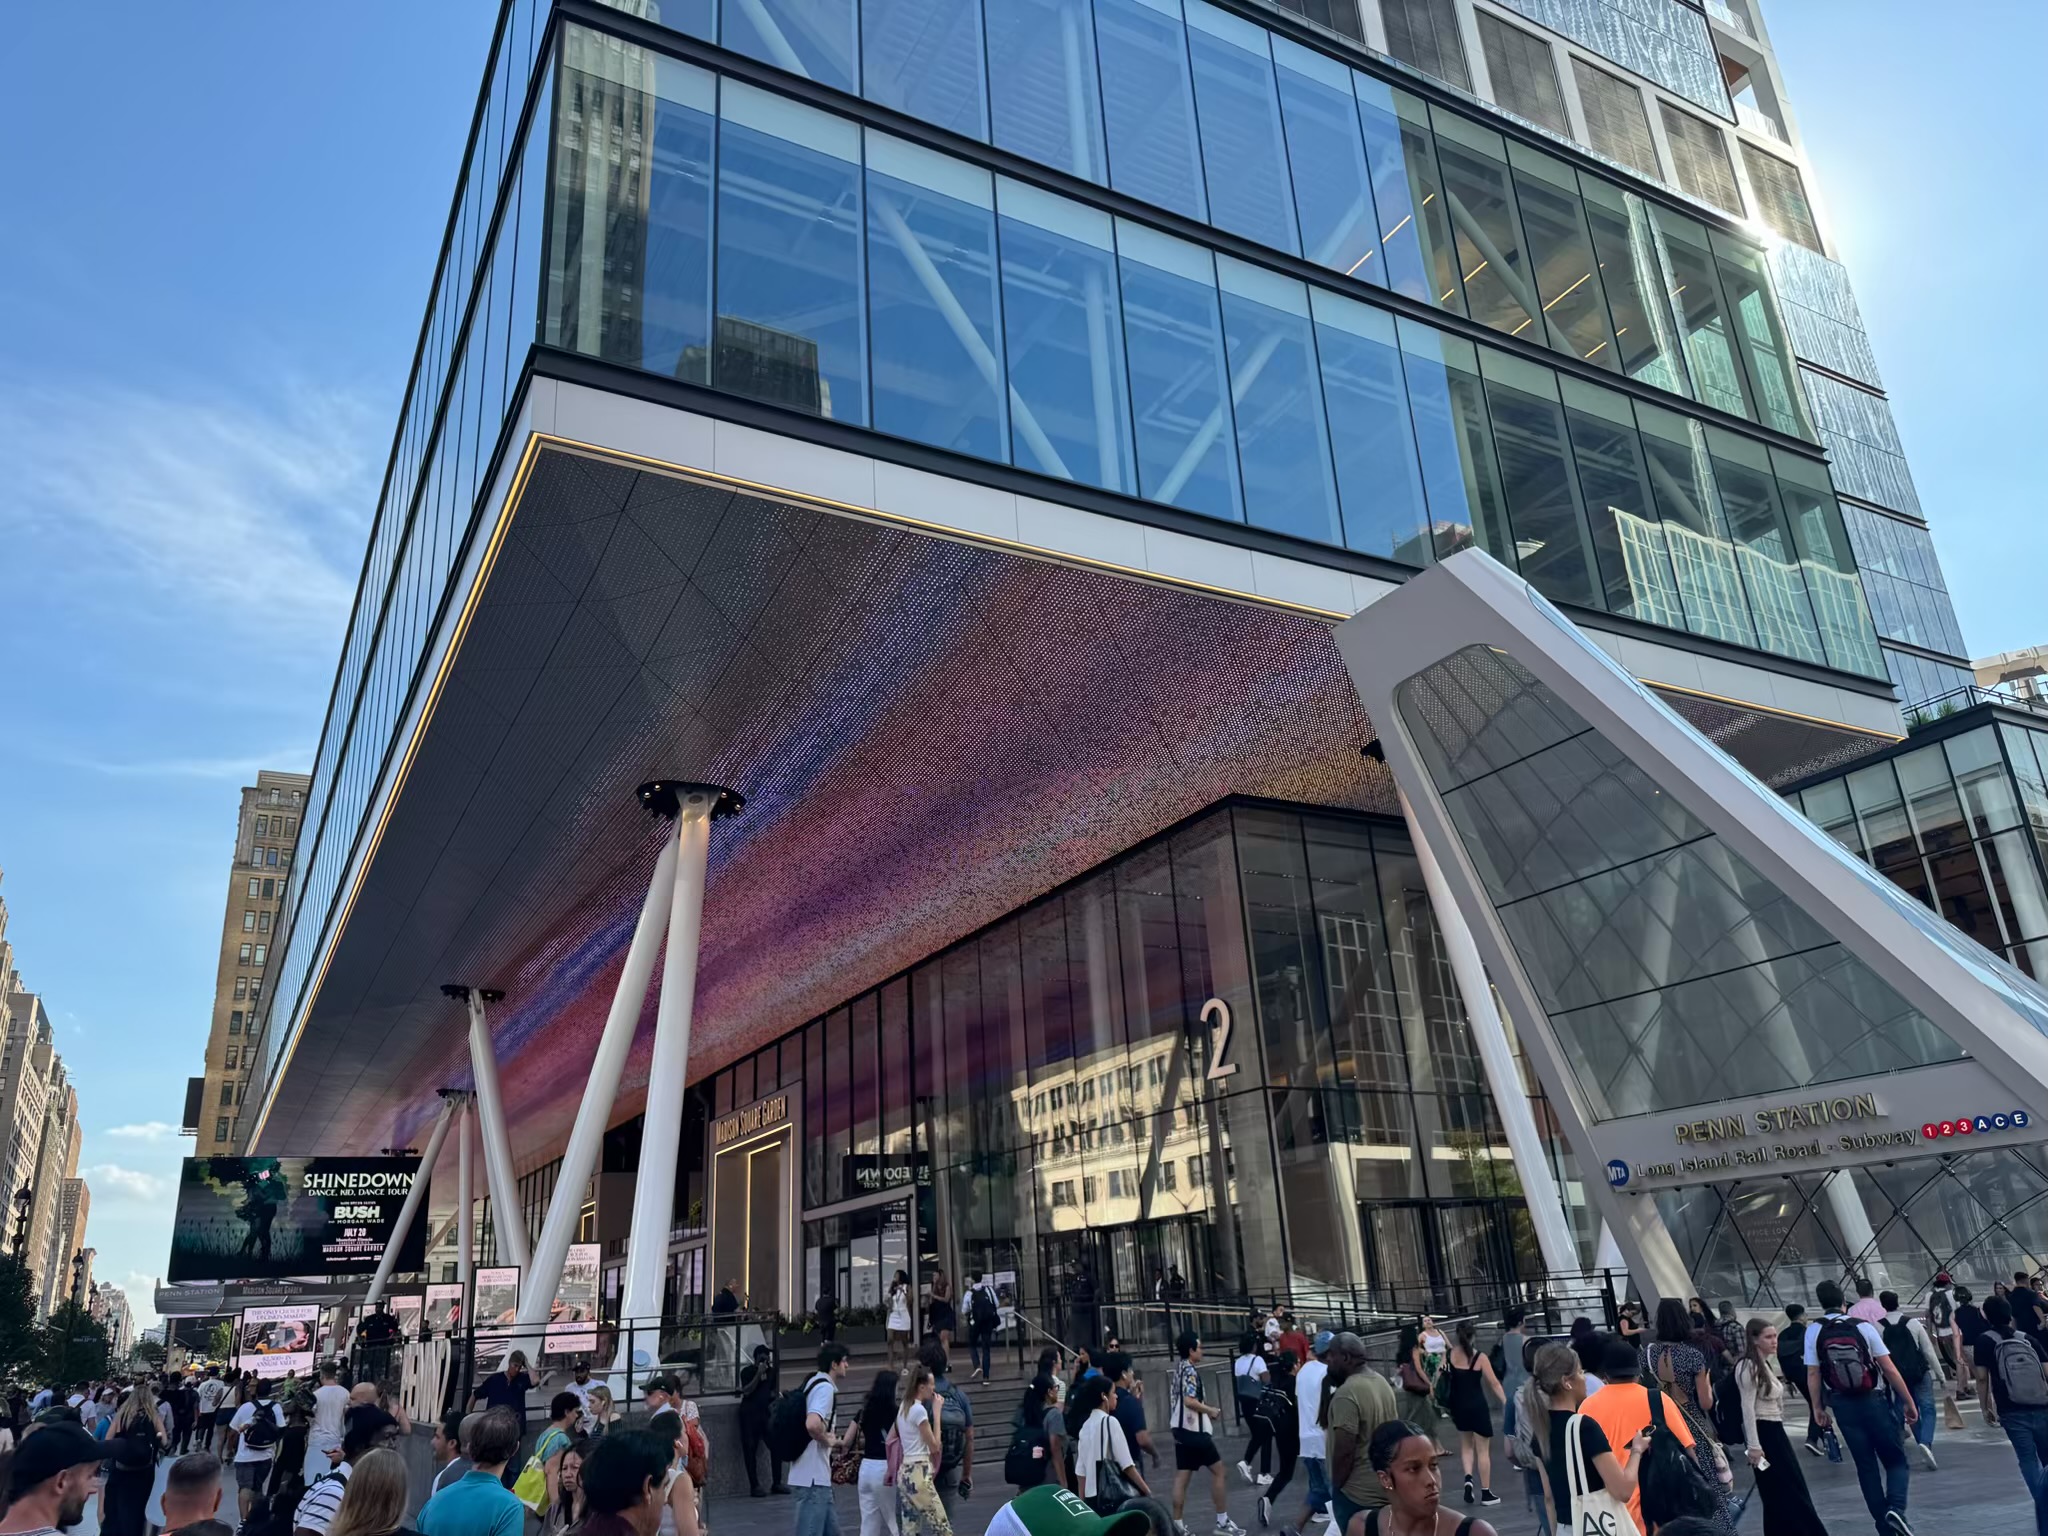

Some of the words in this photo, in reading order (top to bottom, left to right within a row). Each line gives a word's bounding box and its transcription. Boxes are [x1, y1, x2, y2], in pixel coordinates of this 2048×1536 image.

[1200, 998, 1238, 1080] 2
[740, 1106, 762, 1135] SQUARE
[762, 1095, 786, 1126] GARDEN
[1674, 1114, 1748, 1145] PENN
[1754, 1093, 1877, 1133] STATION
[1636, 1163, 1676, 1178] Long
[1680, 1152, 1730, 1172] Island
[1735, 1147, 1768, 1166] Rail
[1773, 1139, 1821, 1160] Road
[1839, 1128, 1917, 1151] Subway
[303, 1172, 416, 1189] SHINEDOWN
[1606, 1165, 1627, 1182] MTA
[358, 1188, 385, 1196] DANCE
[334, 1206, 381, 1219] BUSH
[344, 1227, 358, 1237] JULY
[184, 1288, 220, 1296] STATION
